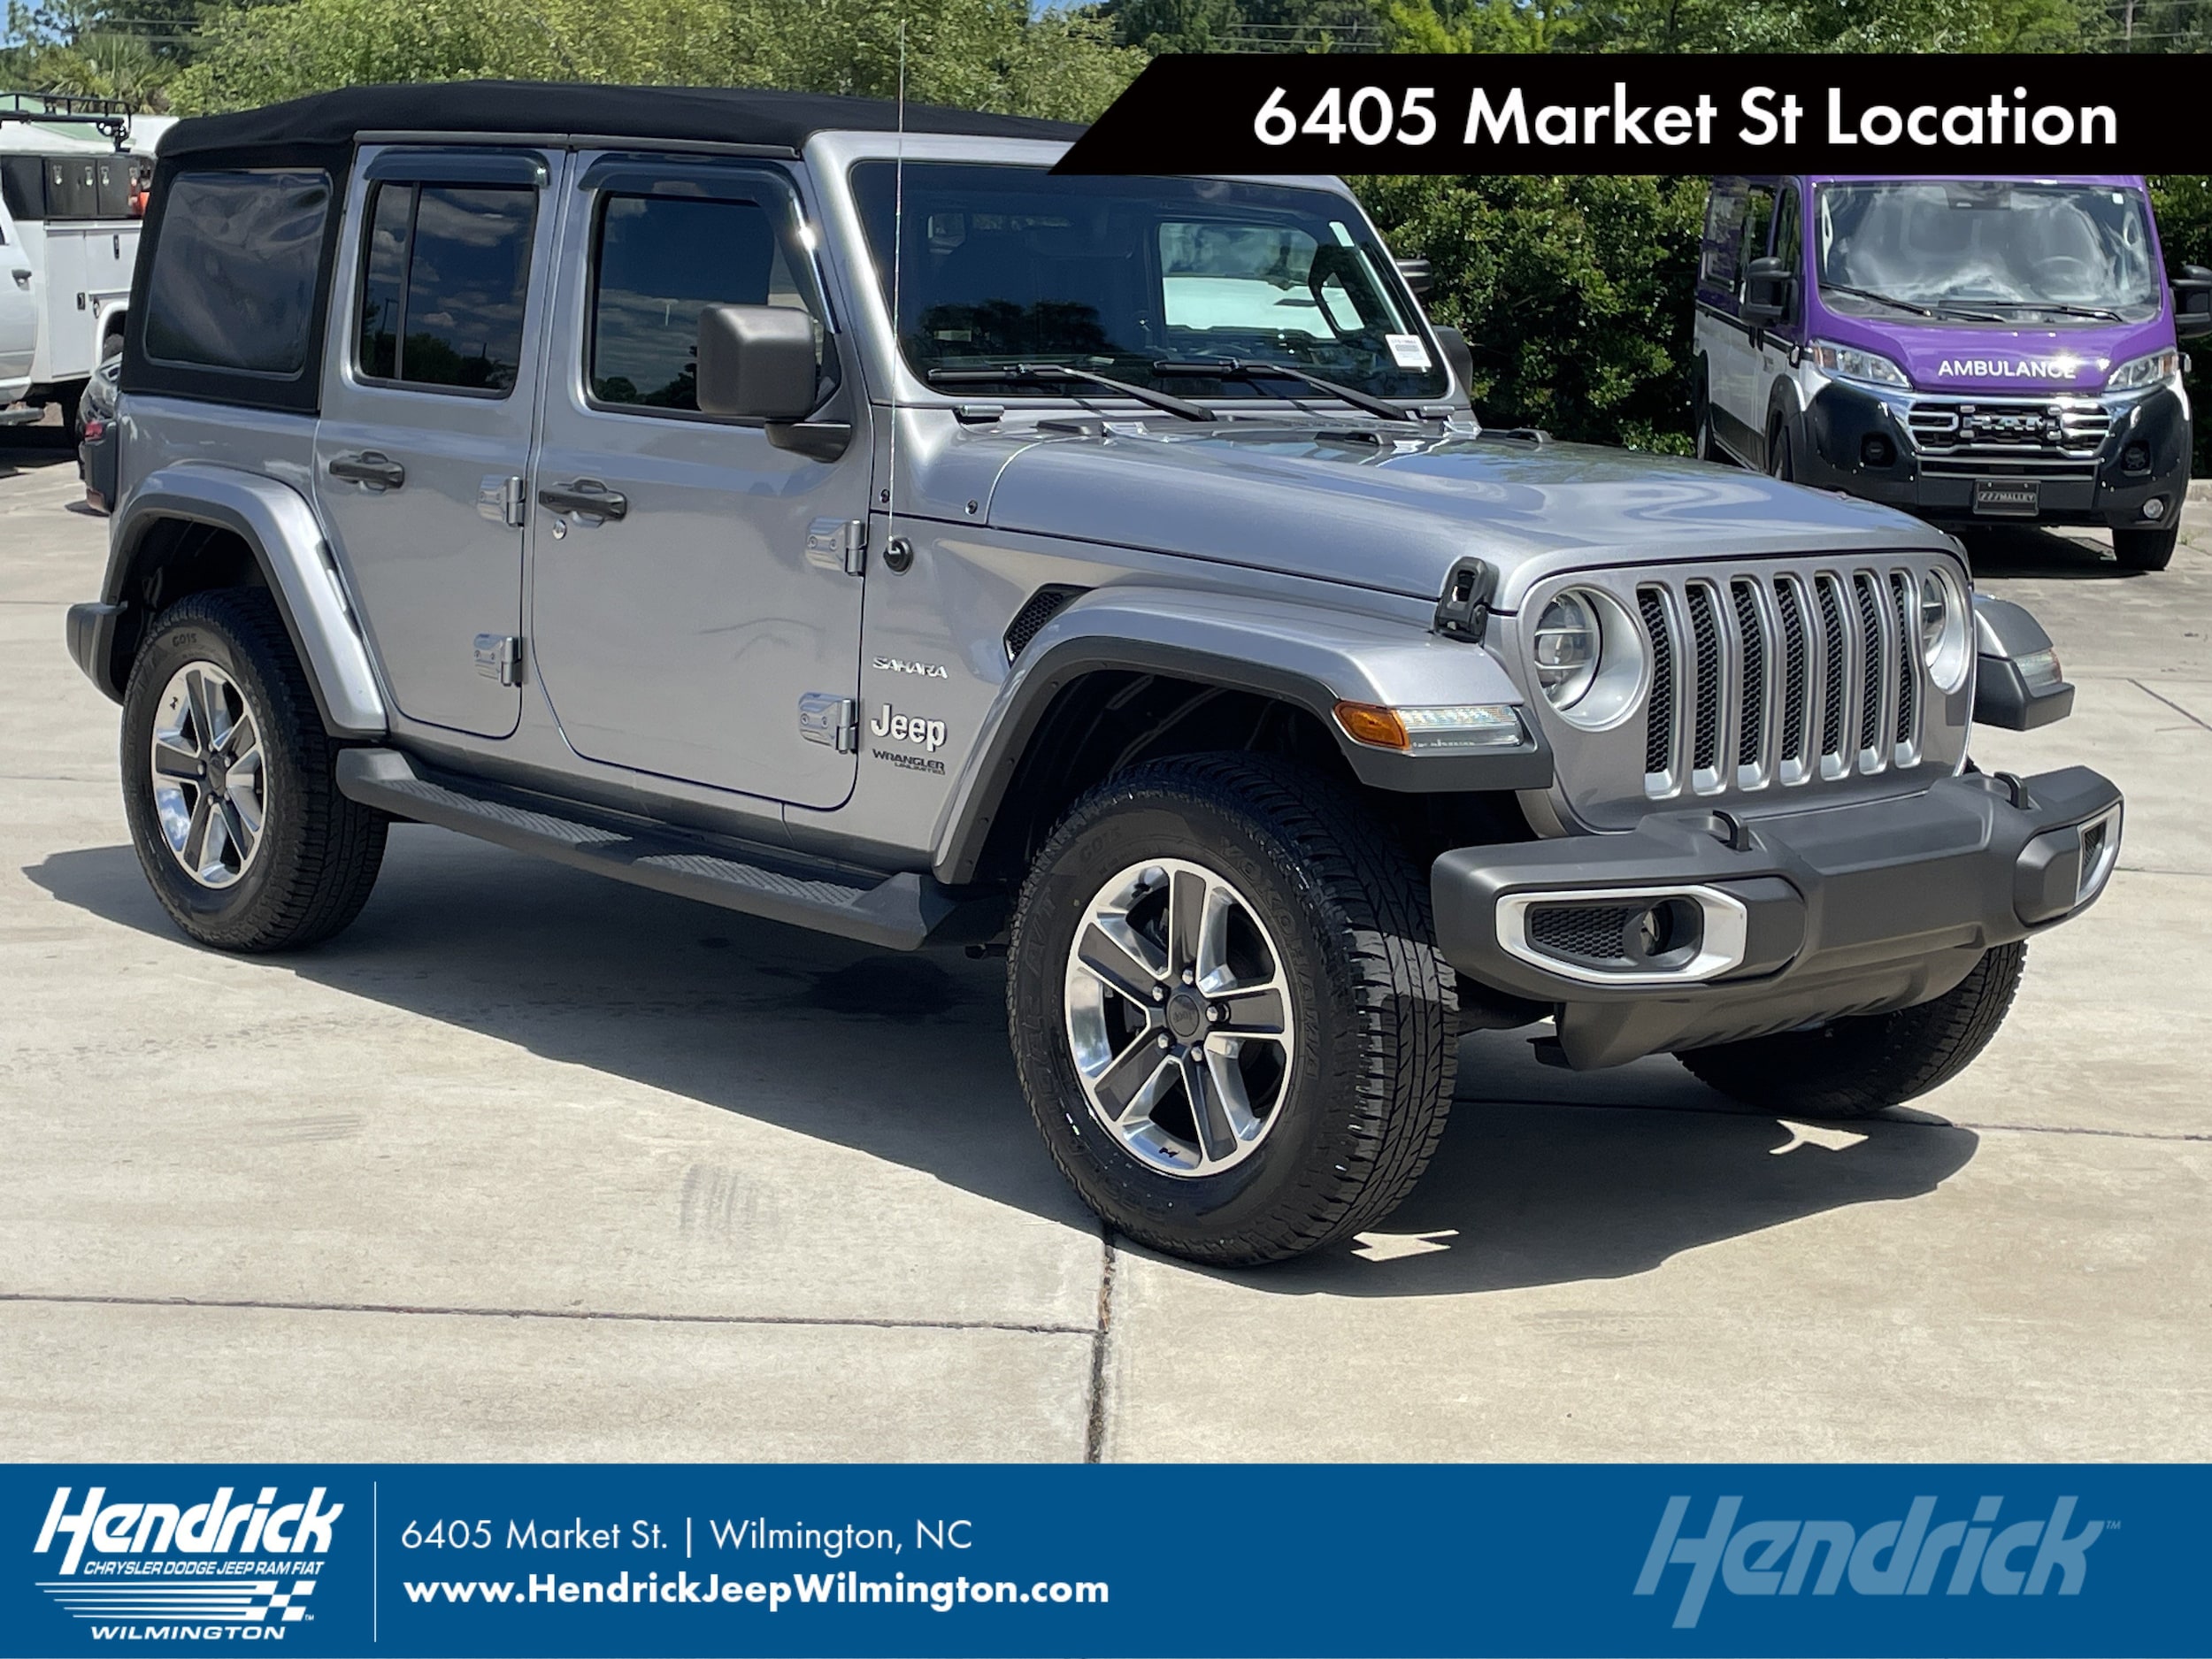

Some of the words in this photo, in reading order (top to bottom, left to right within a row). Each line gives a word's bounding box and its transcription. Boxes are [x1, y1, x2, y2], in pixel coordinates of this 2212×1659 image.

[1938, 360, 2076, 379] AMBULANCE
[872, 657, 948, 679] SAHARA
[871, 703, 947, 752] Jeep
[872, 749, 945, 771] WRANGLER
